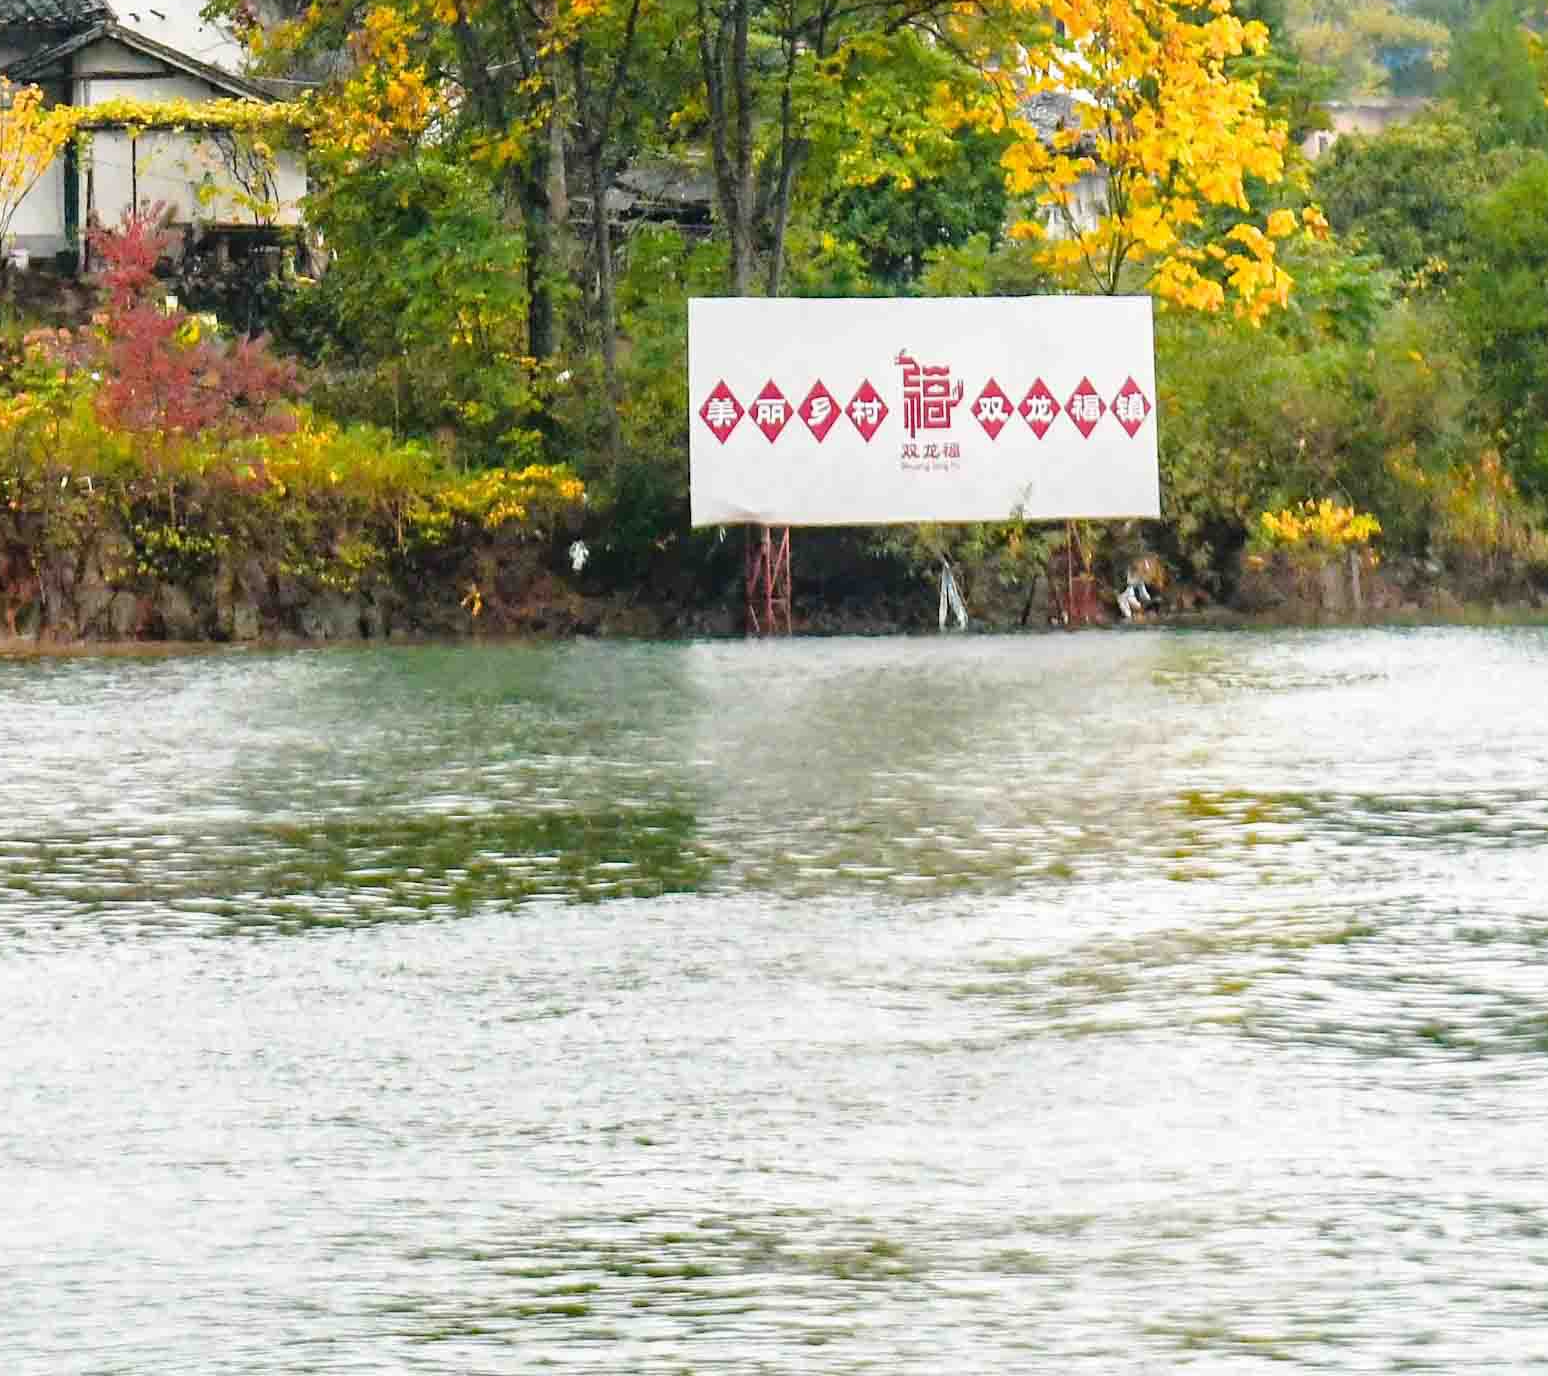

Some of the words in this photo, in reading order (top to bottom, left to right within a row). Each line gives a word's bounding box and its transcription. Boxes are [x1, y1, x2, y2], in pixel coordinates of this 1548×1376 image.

[707, 396, 882, 428] 美丽乡村
[977, 392, 1145, 422] 双龙福镇
[901, 442, 960, 459] 双龙福
